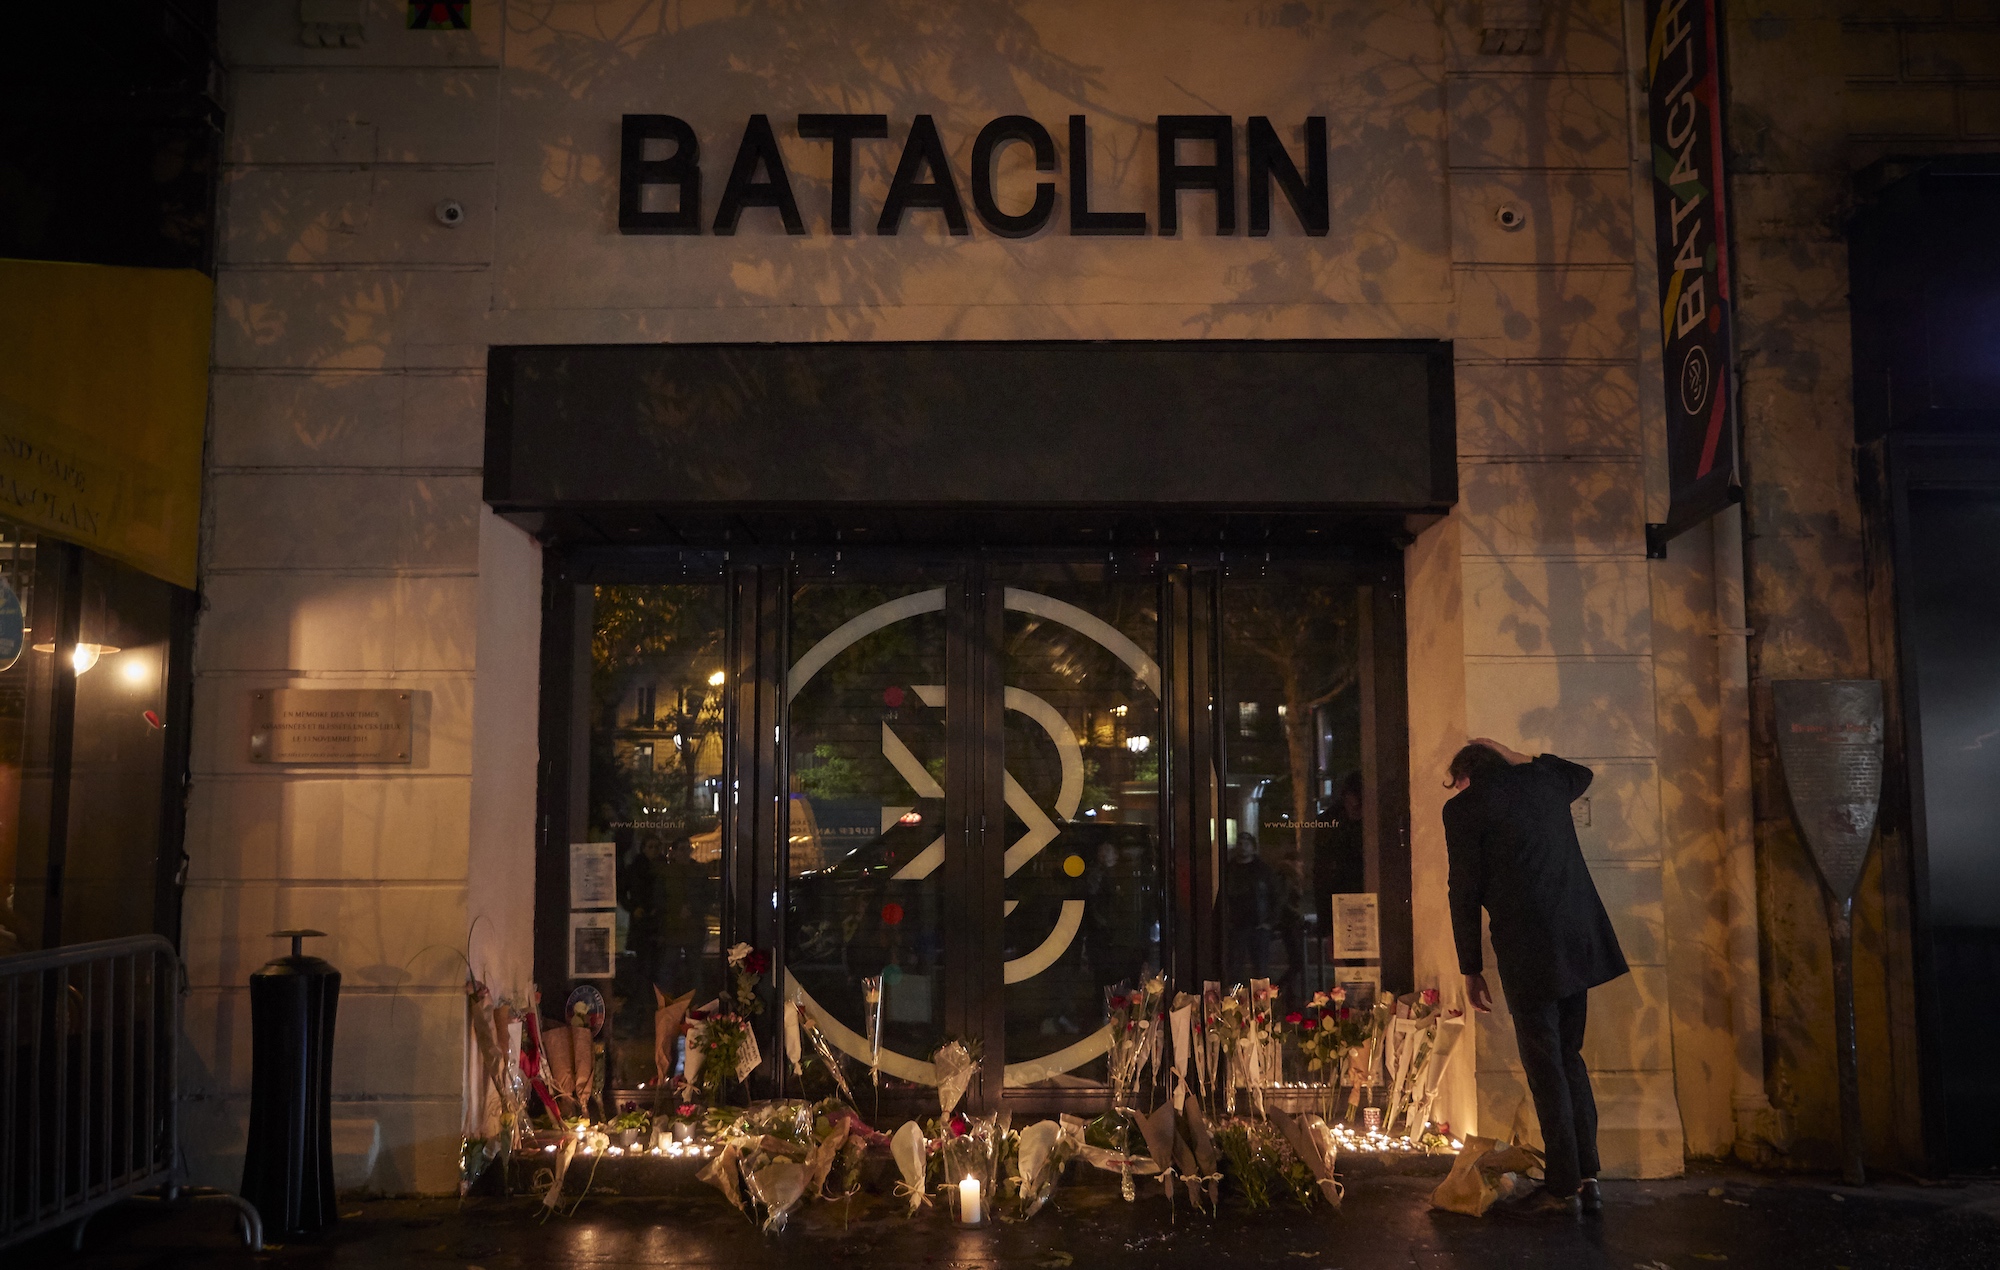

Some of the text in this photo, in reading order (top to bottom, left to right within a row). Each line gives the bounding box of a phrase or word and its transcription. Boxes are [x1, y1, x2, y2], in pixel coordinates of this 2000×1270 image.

[619, 114, 1329, 239] BATACLAN
[380, 723, 401, 731] LIEUX
[609, 819, 686, 830] www.bataclan.fr
[1264, 819, 1341, 829] www.bataclan.fr
